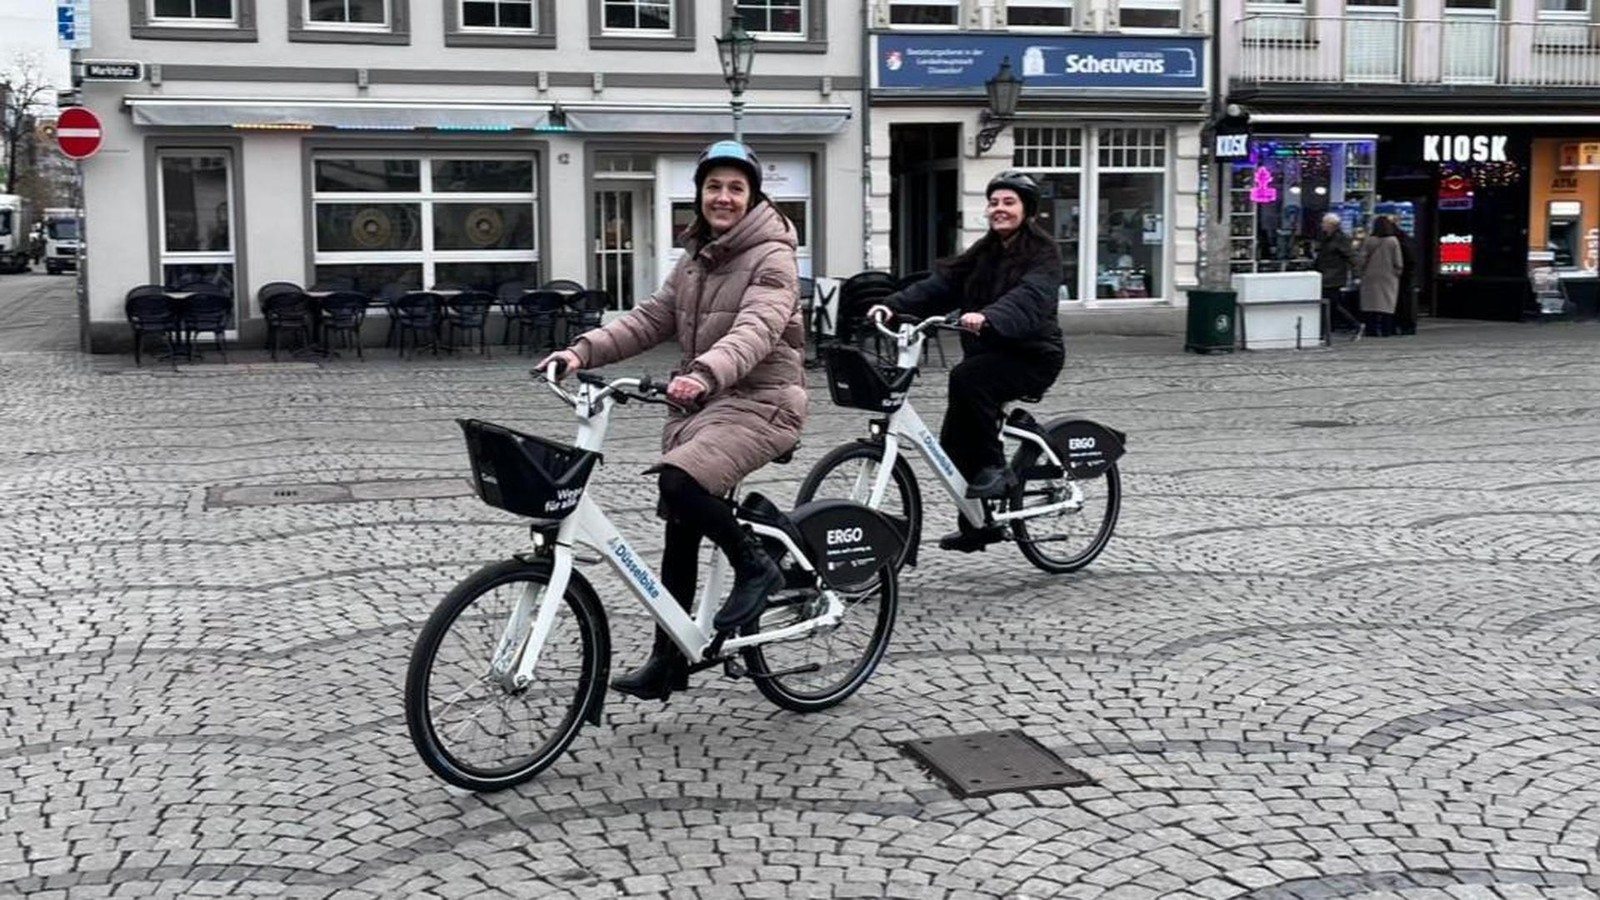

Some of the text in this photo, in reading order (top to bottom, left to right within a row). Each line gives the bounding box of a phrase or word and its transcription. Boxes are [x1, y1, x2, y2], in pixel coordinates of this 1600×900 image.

[91, 66, 134, 78] Marktplatz
[1065, 54, 1165, 74] Scheuvens
[1216, 134, 1249, 157] KIOSK
[1423, 135, 1508, 162] KIOSK
[1551, 177, 1578, 189] ATM
[1583, 228, 1599, 271] Cash
[1068, 436, 1096, 450] ERGO
[826, 526, 863, 546] ERGO
[615, 544, 661, 600] Düsselbike
